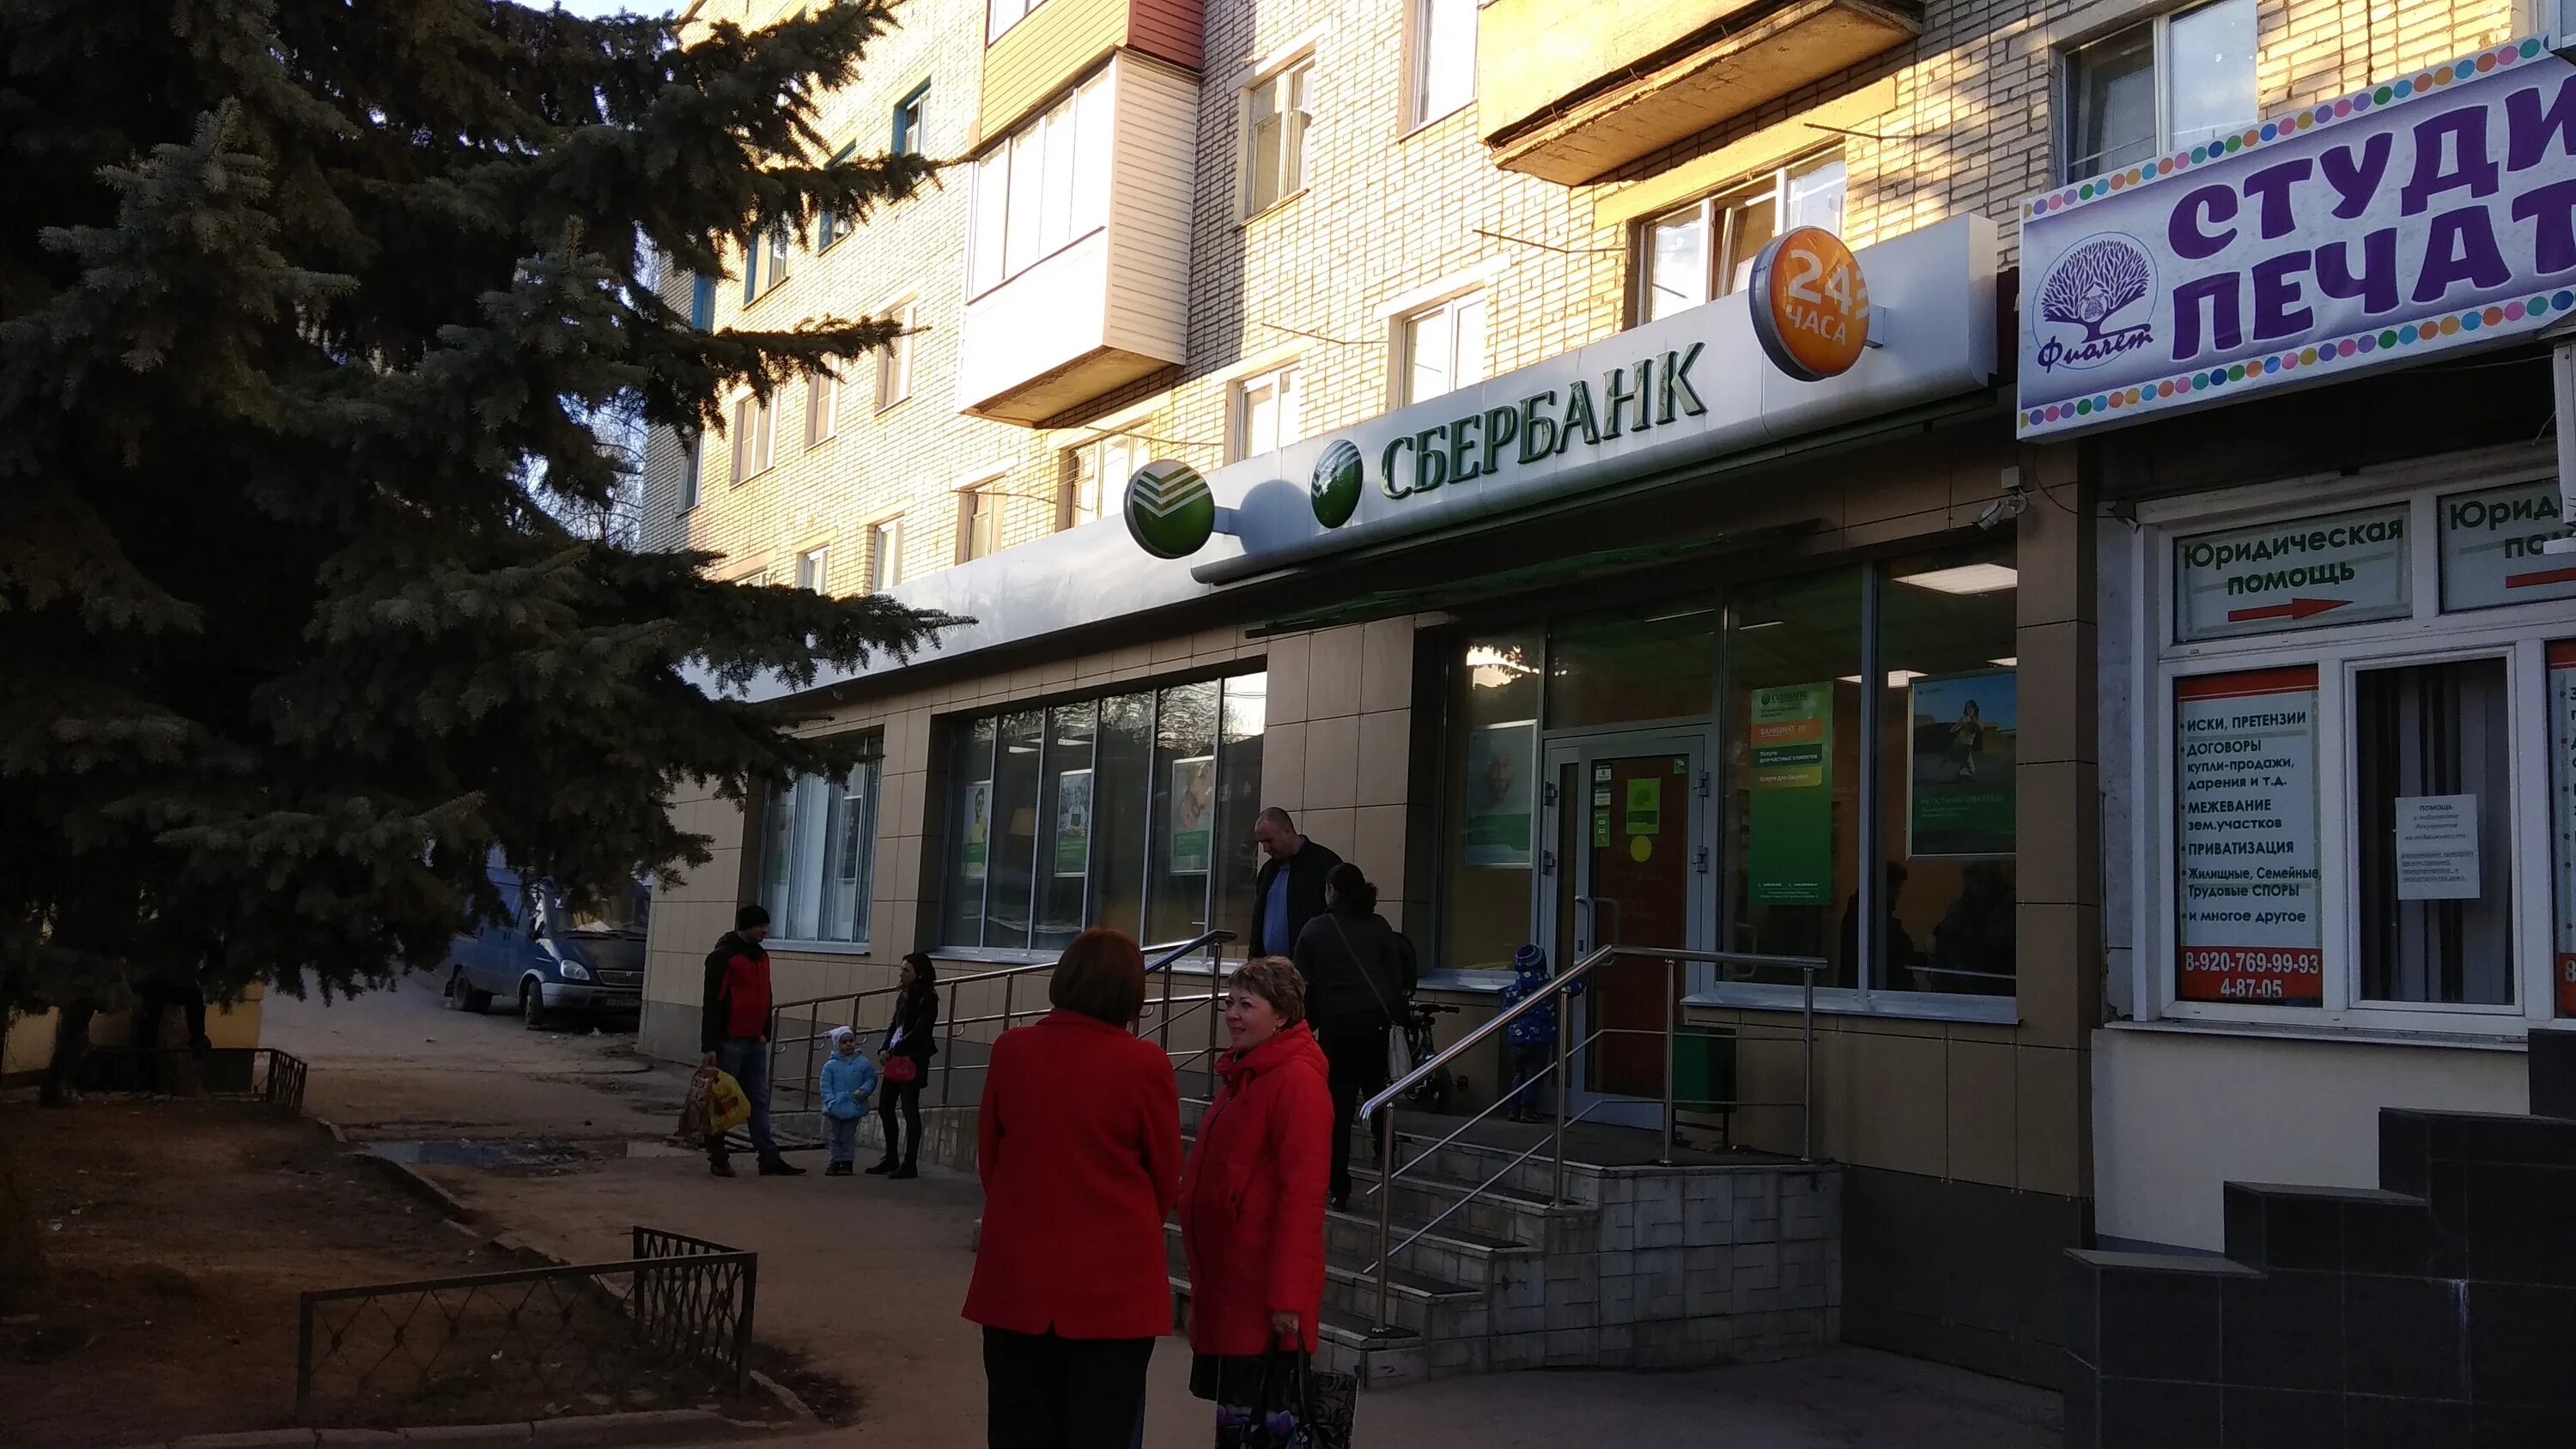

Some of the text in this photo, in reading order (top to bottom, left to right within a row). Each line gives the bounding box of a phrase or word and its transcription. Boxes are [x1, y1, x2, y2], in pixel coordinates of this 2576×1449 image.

[2168, 74, 2576, 259] СТУДИ
[2172, 179, 2576, 361] ПЕЧАТ
[1788, 248, 1853, 316] 24
[1785, 302, 1846, 346] ЧАСА
[2037, 329, 2154, 373] Фиолет
[1381, 341, 1709, 500] СБЕРБАНК
[2451, 495, 2563, 530] Юрид
[2184, 519, 2403, 570] Юридическая
[2227, 562, 2355, 595] помощь
[2187, 711, 2306, 731] ИСКИ, ПРЕТЕНЗИИ
[2186, 740, 2262, 758] ДОГОВОРЫ
[2187, 758, 2295, 774] купли-продажи,
[2187, 776, 2287, 791] дарения и т.д.
[2188, 798, 2272, 814] МЕЖЕВАНИЕ
[2188, 818, 2282, 833] зем.участков
[2188, 841, 2294, 856] ПРИВАТИЗАЦИЯ
[2188, 865, 2322, 881] Жилищные, Семейные,
[2188, 883, 2300, 899] Трудовые СПОРЫ
[2189, 912, 2306, 925] и многое другое
[2184, 951, 2320, 975] 8-920-769-99-93
[2221, 978, 2284, 998] 4-87-05
